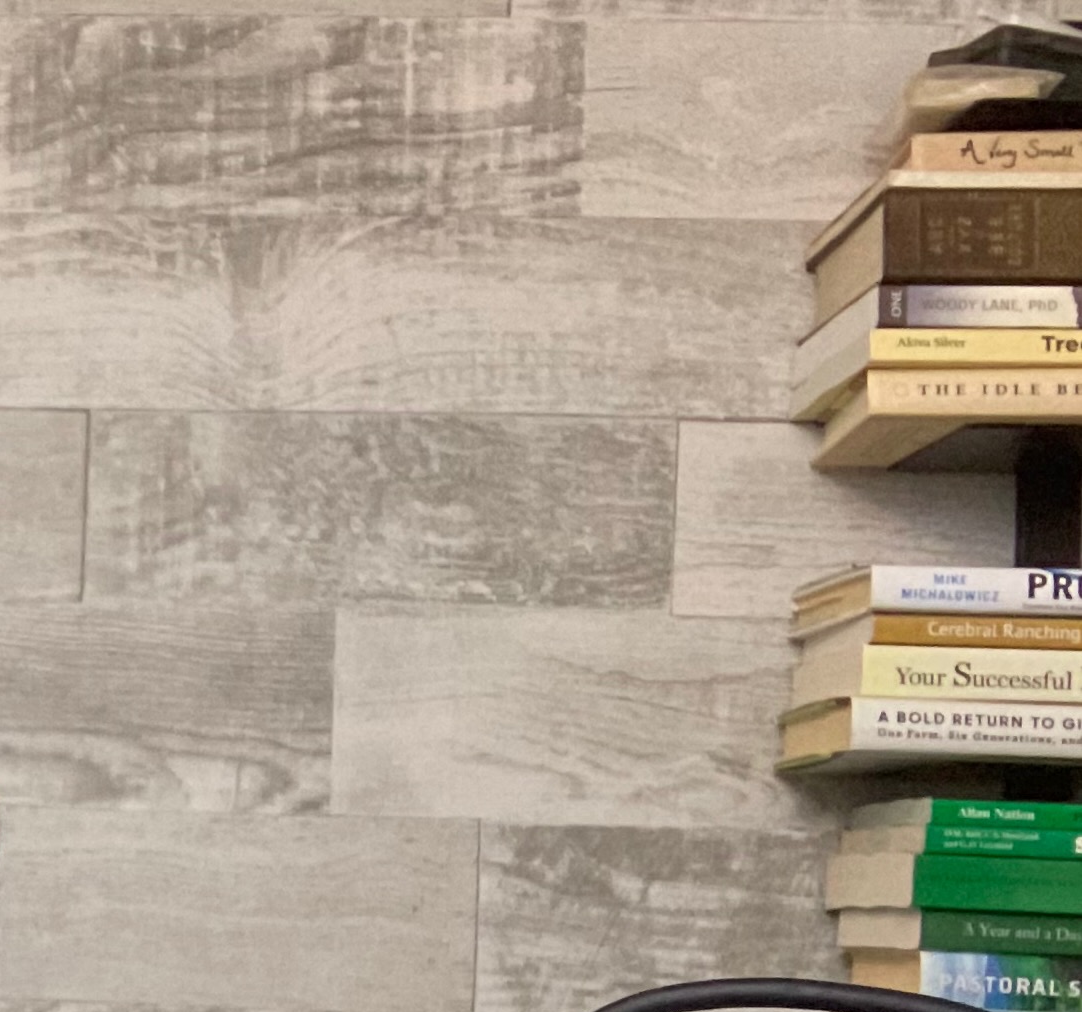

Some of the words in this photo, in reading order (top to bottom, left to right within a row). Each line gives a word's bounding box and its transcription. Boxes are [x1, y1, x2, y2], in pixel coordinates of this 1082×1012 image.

[960, 139, 985, 165] A
[1024, 138, 1074, 159] Small
[921, 299, 975, 312] WOODY
[1029, 299, 1058, 312] PhD
[934, 336, 966, 349] Silver
[918, 384, 967, 396] THE
[982, 384, 1041, 396] IDLE
[934, 573, 966, 586] MIKE
[1028, 573, 1082, 600] PR
[901, 588, 1000, 603] MICHALOWICZ
[927, 621, 997, 638] Cerebral
[1003, 623, 1082, 644] Ranching
[895, 667, 948, 687] Your
[953, 661, 1072, 690] Successful
[878, 711, 889, 722] A
[897, 711, 945, 724] BOLD
[952, 713, 1023, 728] RETURN
[1031, 716, 1055, 730] TO
[877, 728, 903, 738] One
[949, 731, 967, 741] Six
[958, 807, 991, 819] Allan
[995, 808, 1035, 821] Nation
[963, 922, 974, 937] A
[979, 922, 1011, 938] Year
[1015, 926, 1040, 940] and
[1044, 931, 1052, 940] a
[941, 974, 1060, 997] PASTORAL
[1068, 980, 1081, 997] S
